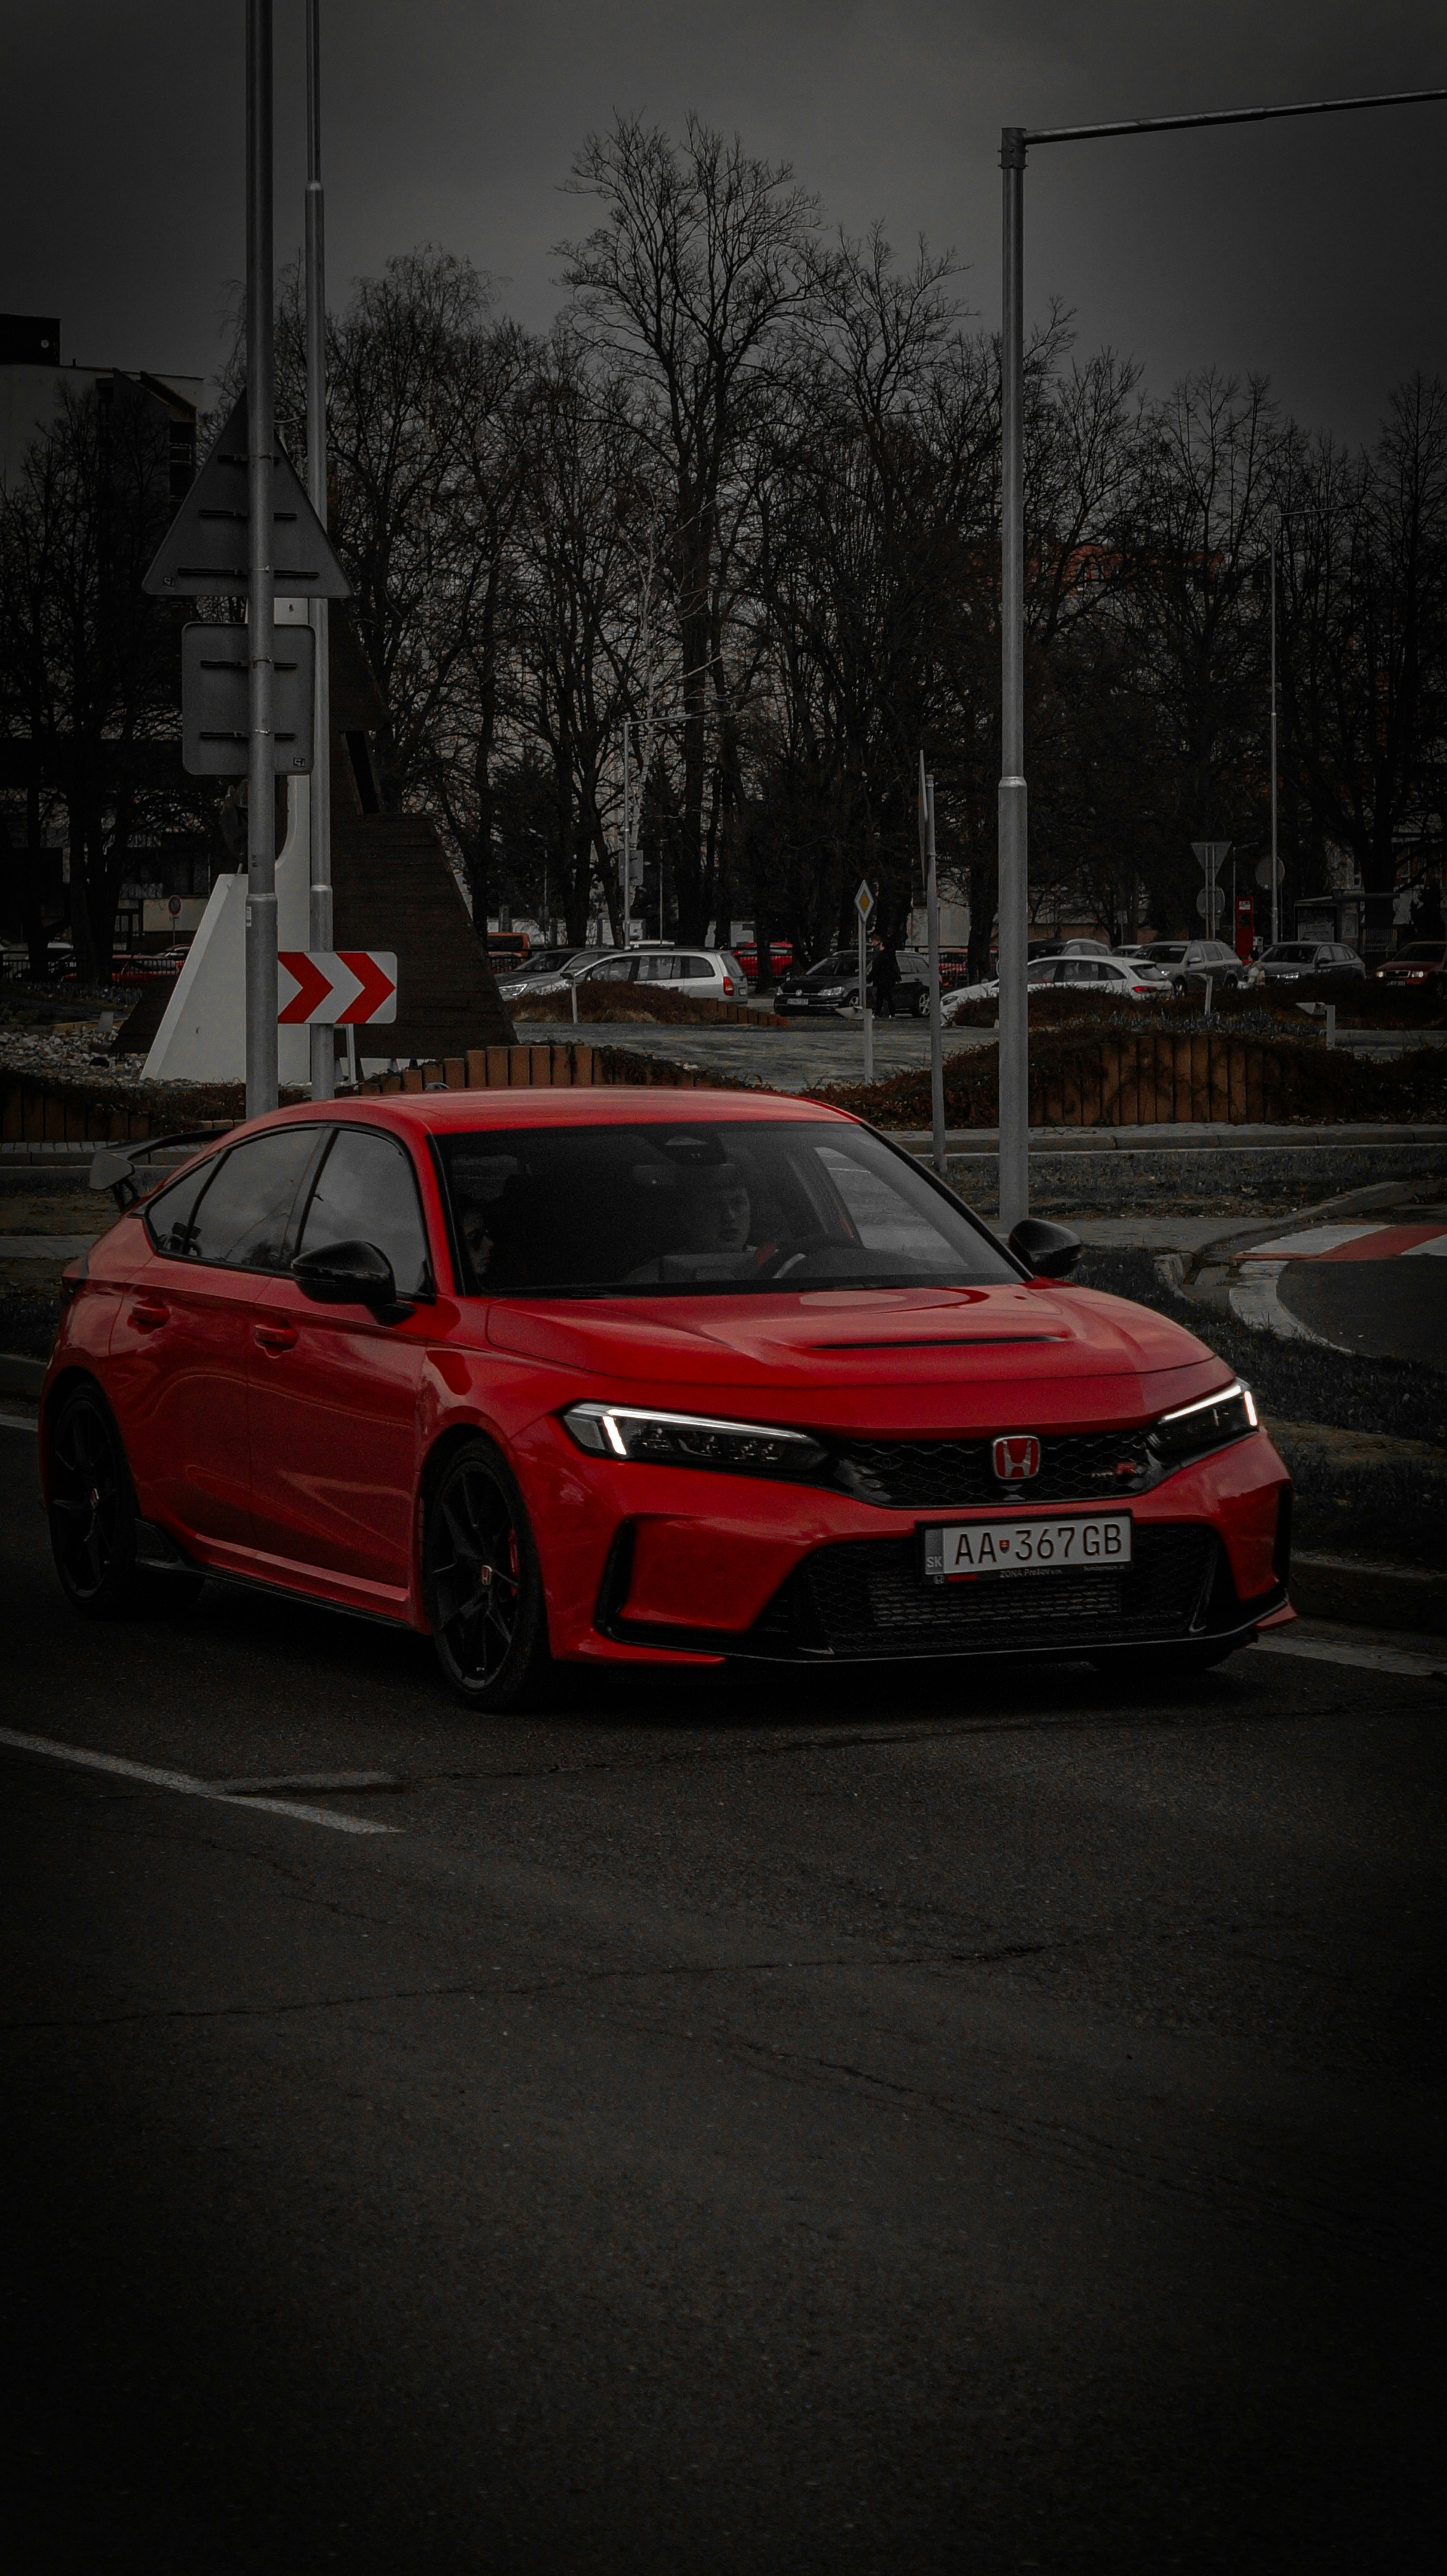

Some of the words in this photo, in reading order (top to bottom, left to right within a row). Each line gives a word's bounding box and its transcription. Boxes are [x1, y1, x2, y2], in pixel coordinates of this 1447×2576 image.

[955, 1532, 997, 1565] AA
[1015, 1524, 1121, 1560] 367GB
[926, 1555, 942, 1568] SK
